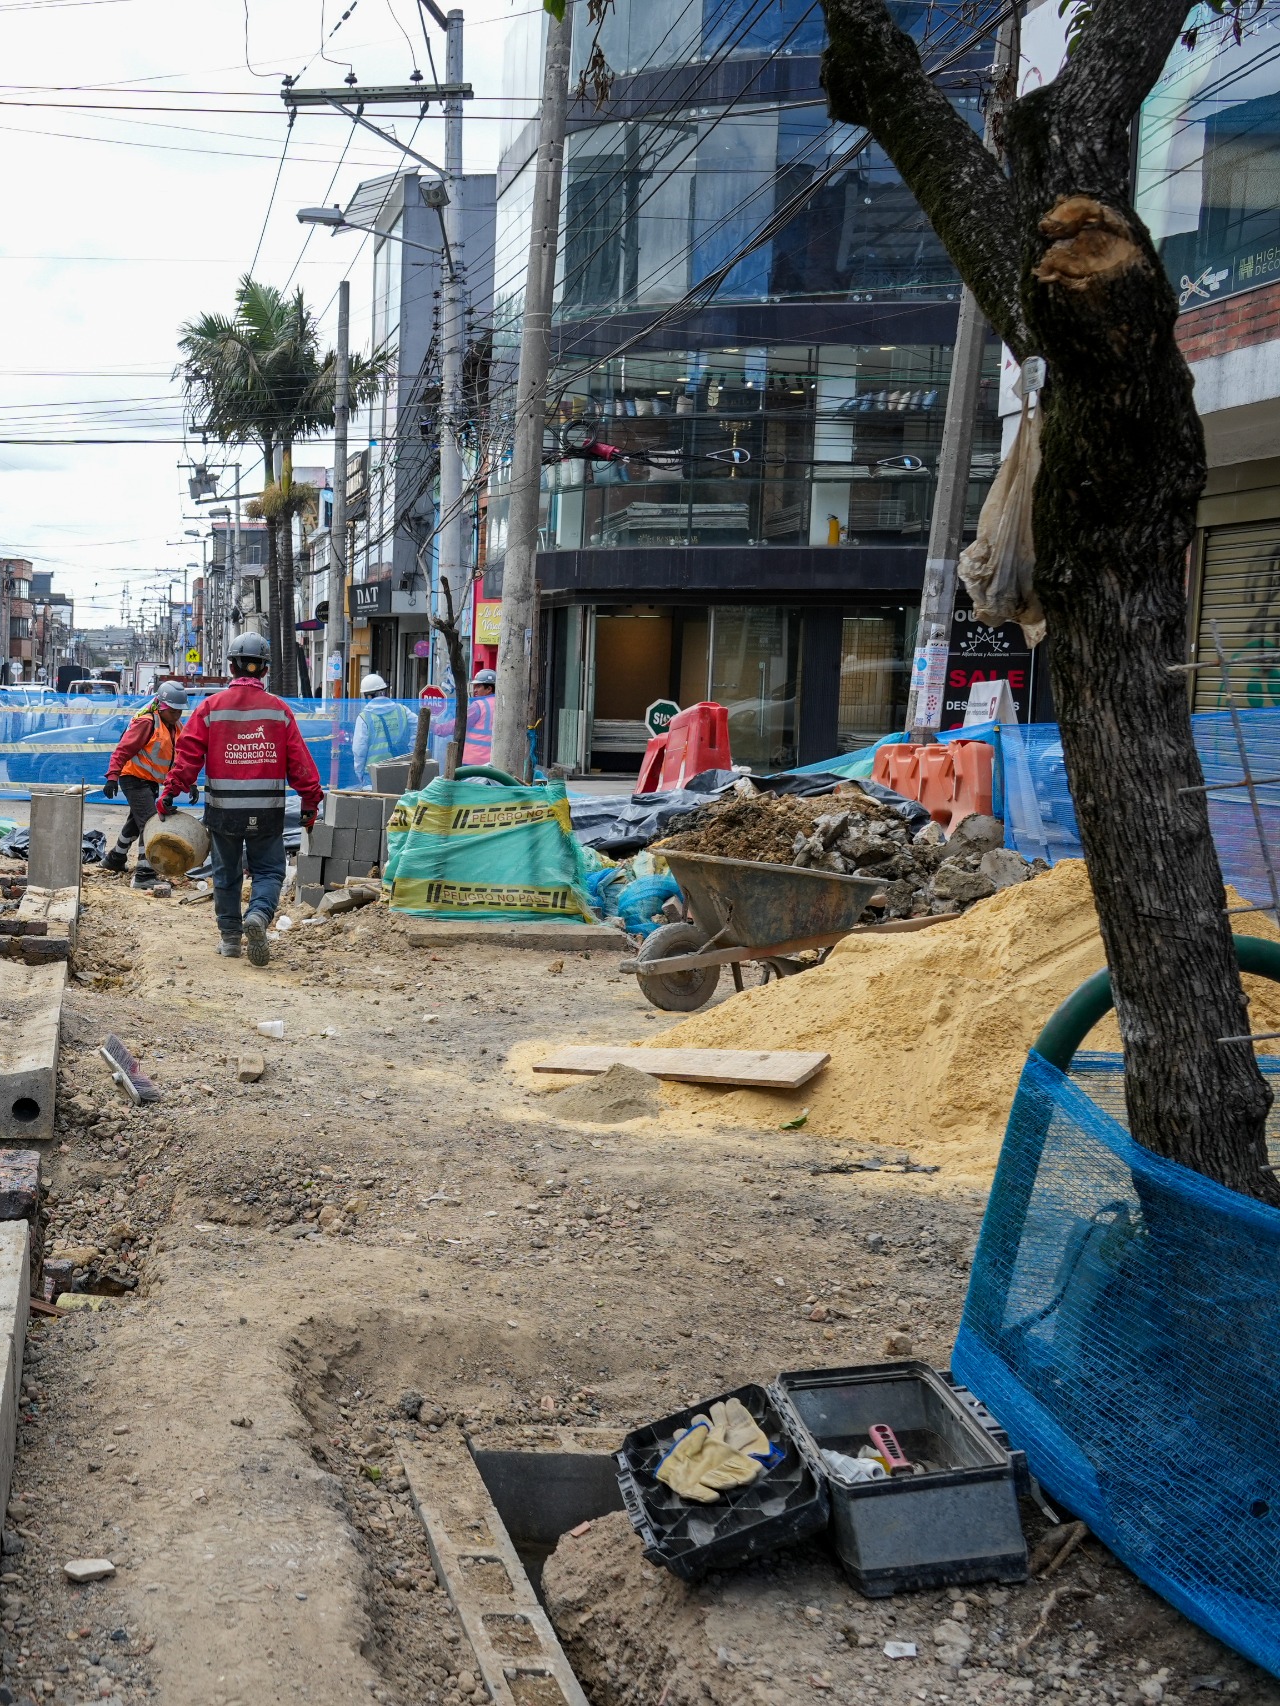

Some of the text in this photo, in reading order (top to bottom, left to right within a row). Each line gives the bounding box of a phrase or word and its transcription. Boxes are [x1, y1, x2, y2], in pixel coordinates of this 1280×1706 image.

[423, 695, 443, 708] PARE
[226, 742, 276, 752] CONTRATO
[224, 750, 278, 760] CONSORCIO CCA
[472, 811, 524, 824] PELIGRO
[526, 809, 543, 819] NO
[443, 890, 550, 904] PELIGRO NO PASE
